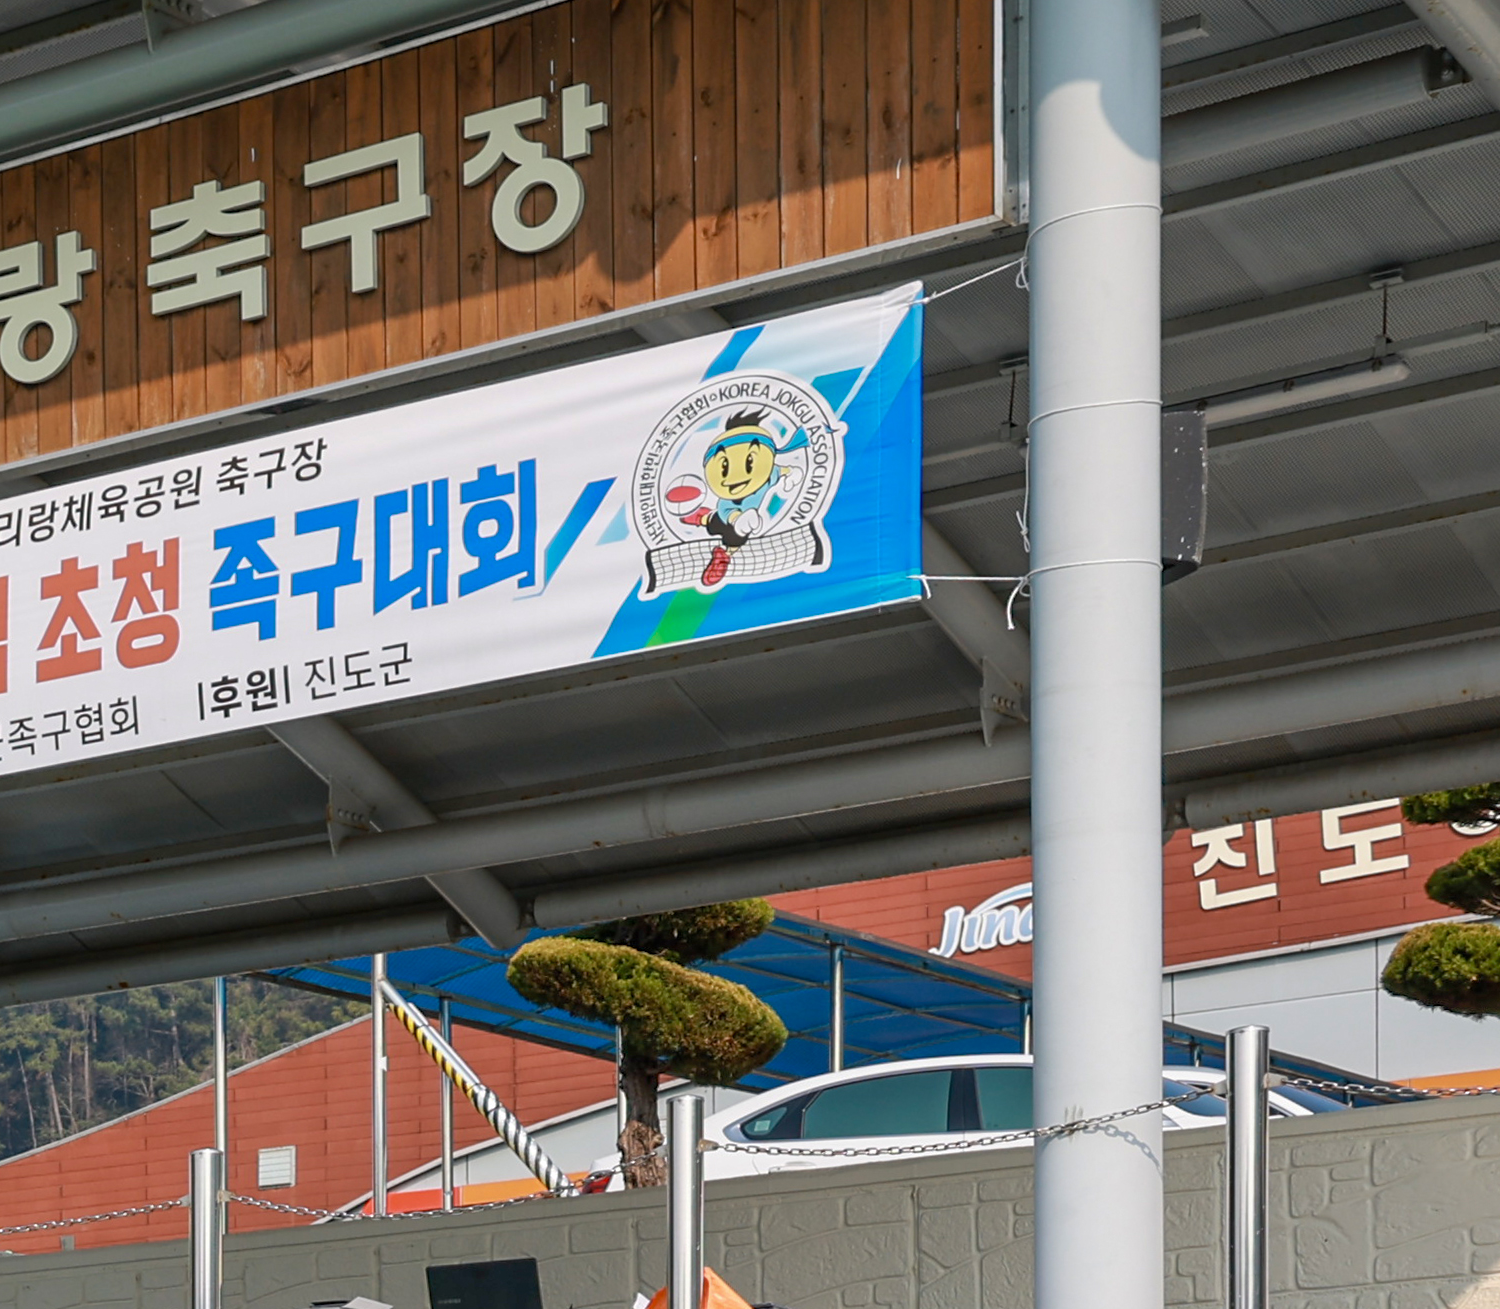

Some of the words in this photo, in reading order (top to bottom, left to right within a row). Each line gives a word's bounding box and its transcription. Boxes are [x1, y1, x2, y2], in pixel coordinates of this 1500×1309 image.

[147, 83, 607, 321] 축구장
[718, 382, 771, 401] KOREA
[772, 388, 816, 426] JOKGU
[216, 438, 328, 495] 축구장
[788, 424, 829, 526] ASSOCIATION
[35, 537, 181, 683] 초청
[209, 457, 537, 641] 족구대회
[305, 642, 413, 699] 진도군
